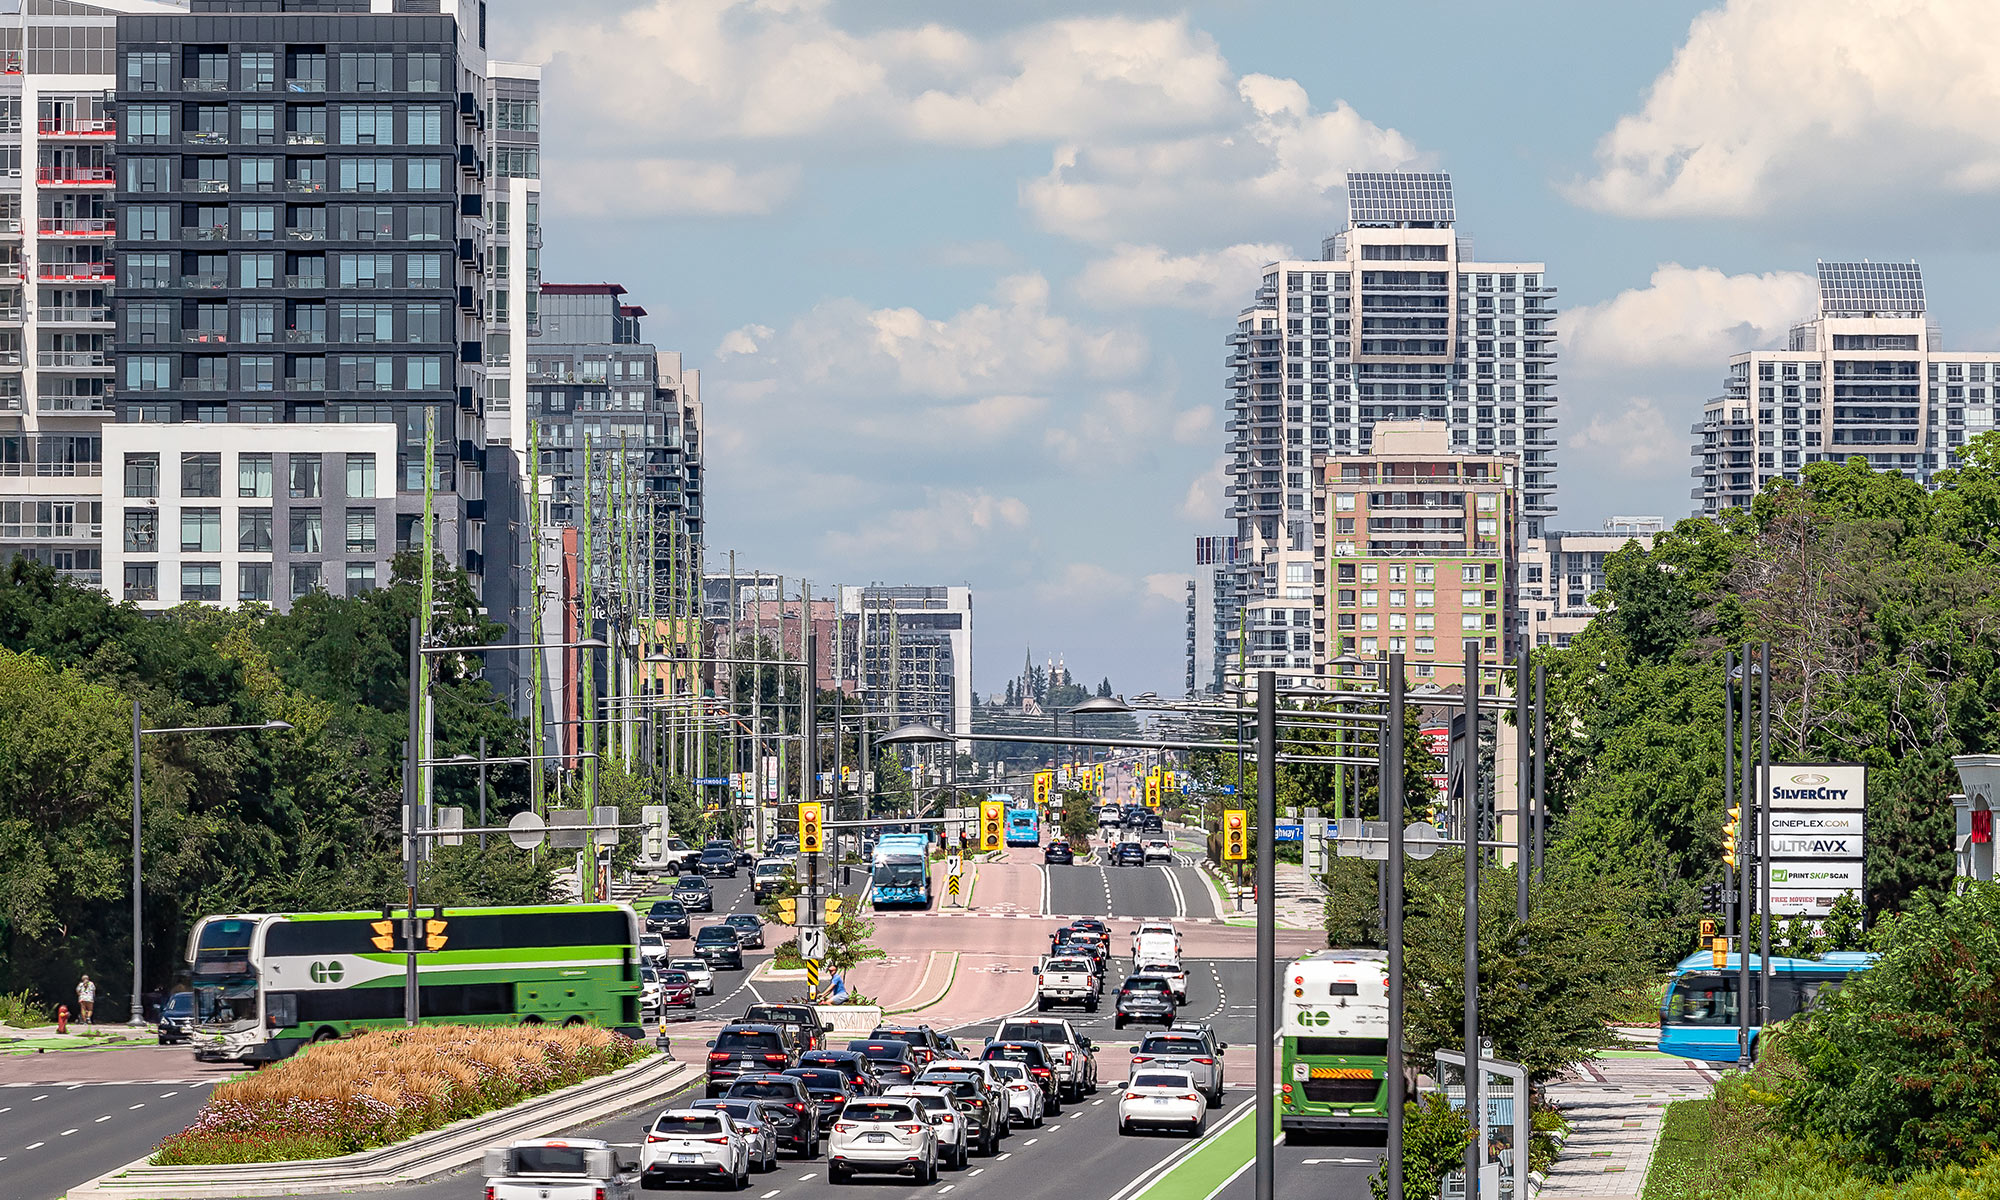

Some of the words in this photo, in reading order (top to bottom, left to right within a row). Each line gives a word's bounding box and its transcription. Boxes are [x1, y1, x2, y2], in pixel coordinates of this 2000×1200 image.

[1771, 819, 1849, 828] CINEPLEX.COM
[1275, 828, 1295, 839] ghway
[1809, 872, 1829, 880] SKIP
[310, 960, 345, 984] GO
[1297, 1010, 1330, 1027] GO
